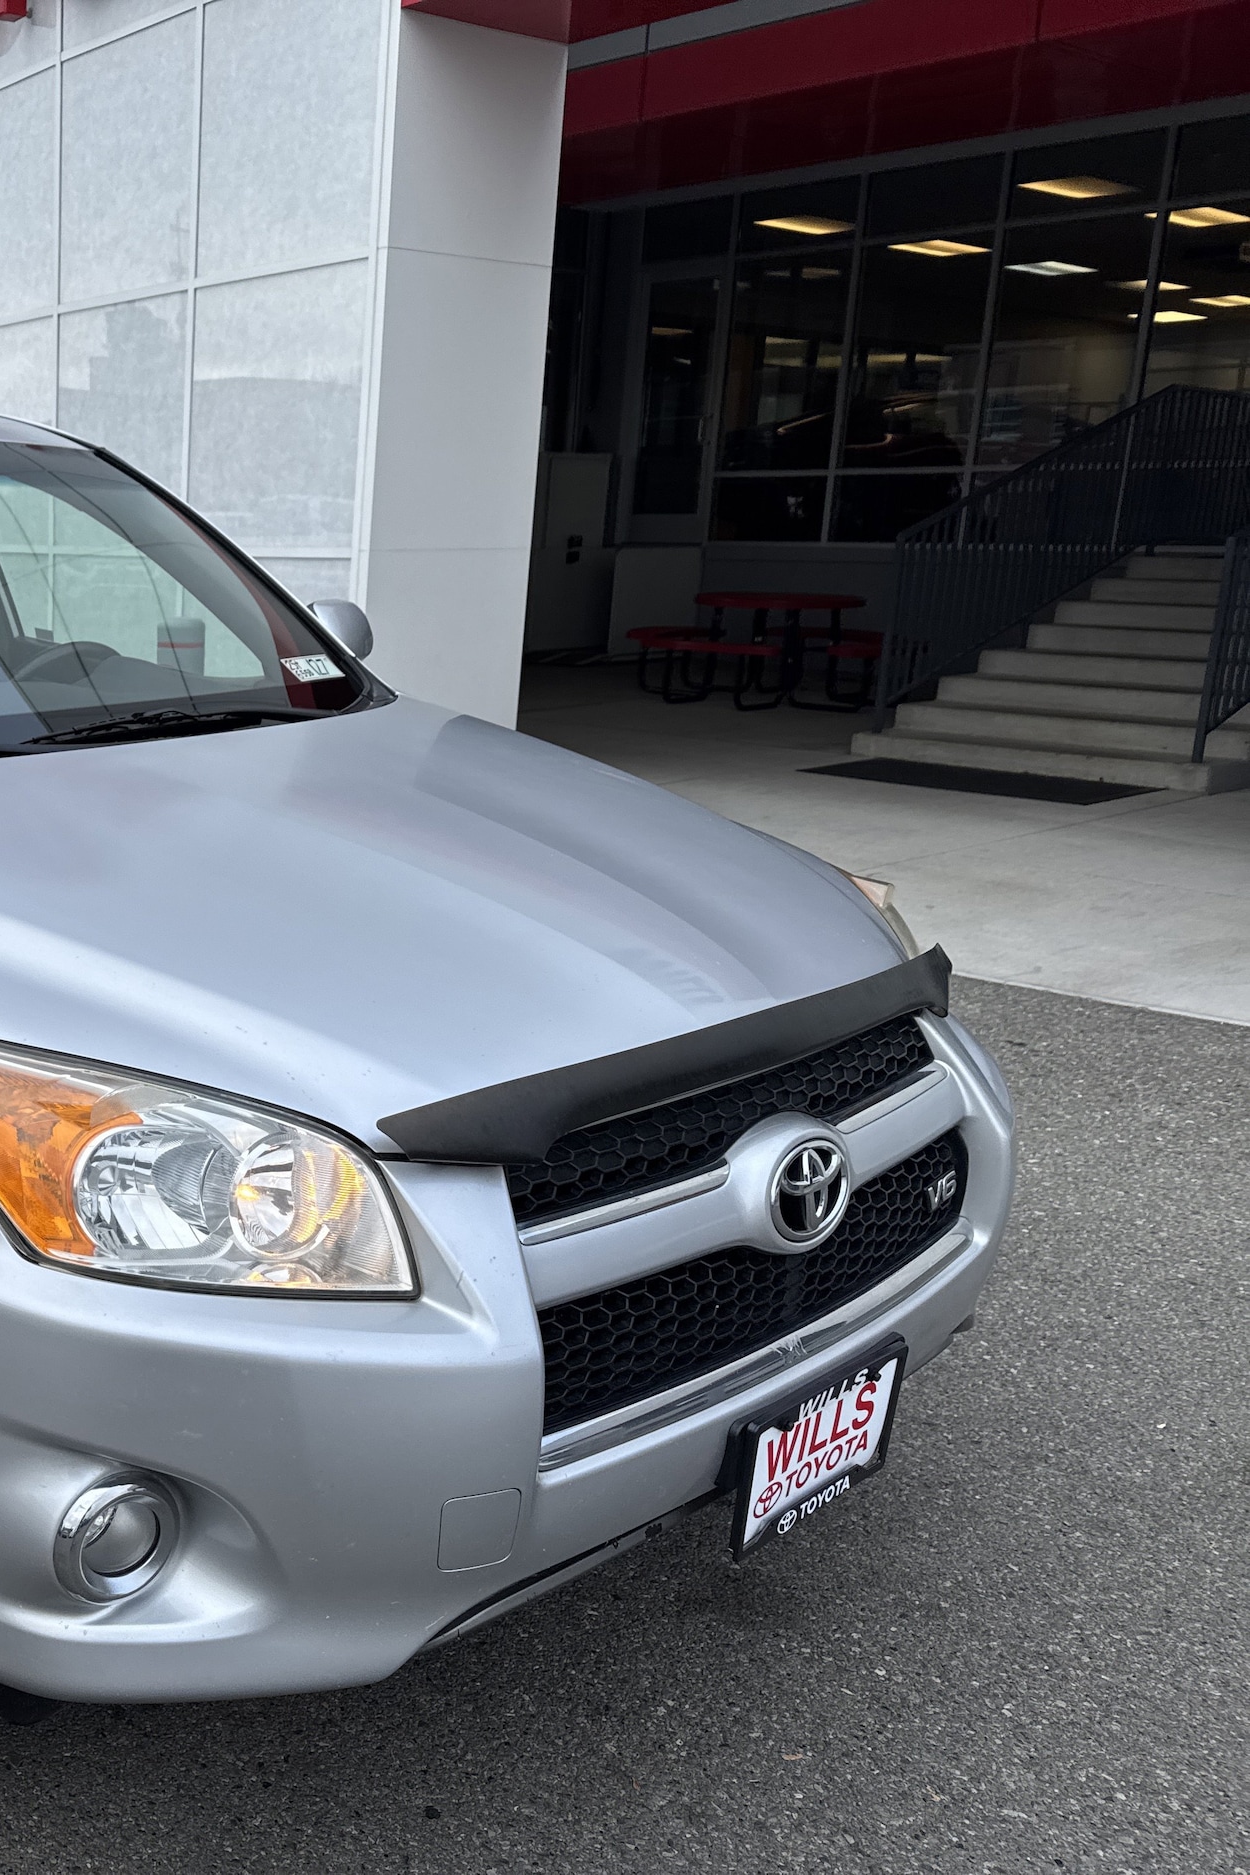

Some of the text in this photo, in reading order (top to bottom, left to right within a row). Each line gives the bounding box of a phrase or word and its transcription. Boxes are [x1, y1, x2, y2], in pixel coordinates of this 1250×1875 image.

[928, 1170, 957, 1210] V6
[800, 1368, 869, 1418] WILLS
[767, 1381, 877, 1482] WILLS
[786, 1430, 868, 1498] TOYOTA
[800, 1475, 851, 1519] TOYOTA
